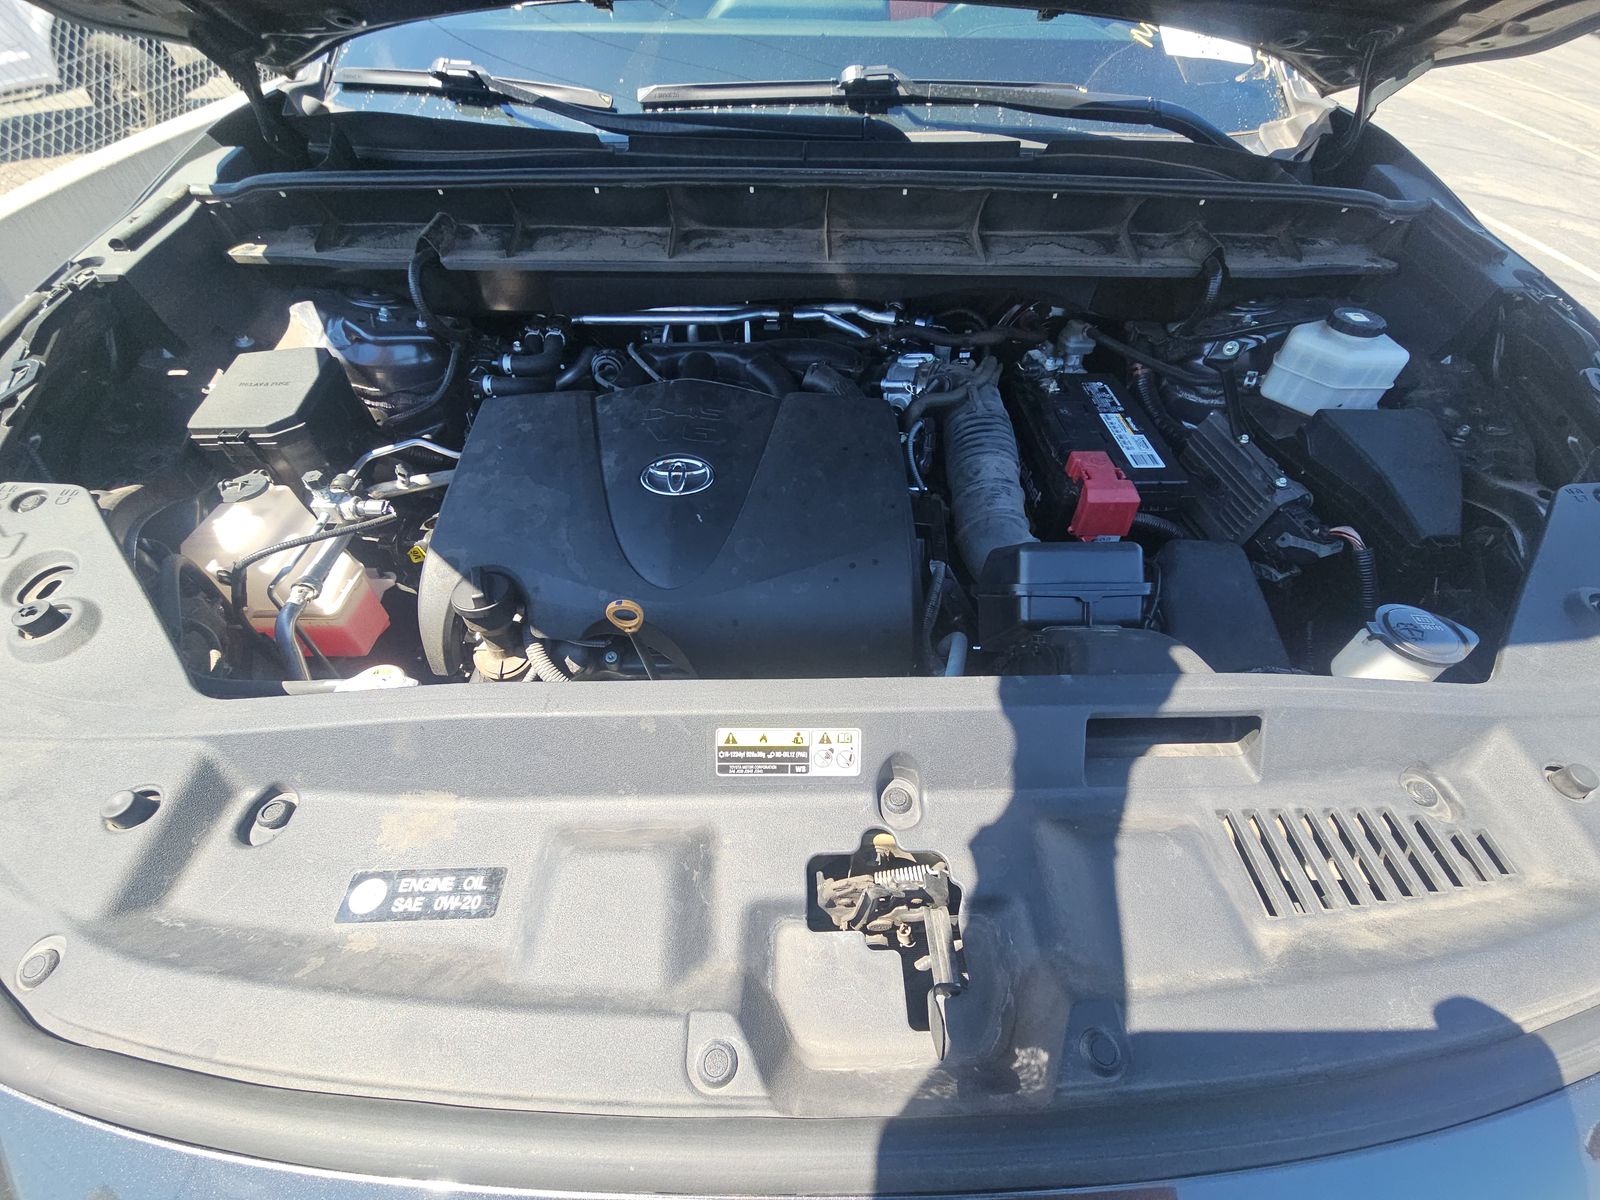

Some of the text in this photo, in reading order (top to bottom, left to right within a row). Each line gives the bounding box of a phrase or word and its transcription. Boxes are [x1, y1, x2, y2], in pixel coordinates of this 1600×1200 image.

[398, 876, 488, 893] ENGINE OIL
[391, 895, 482, 912] SAE 0W-20
